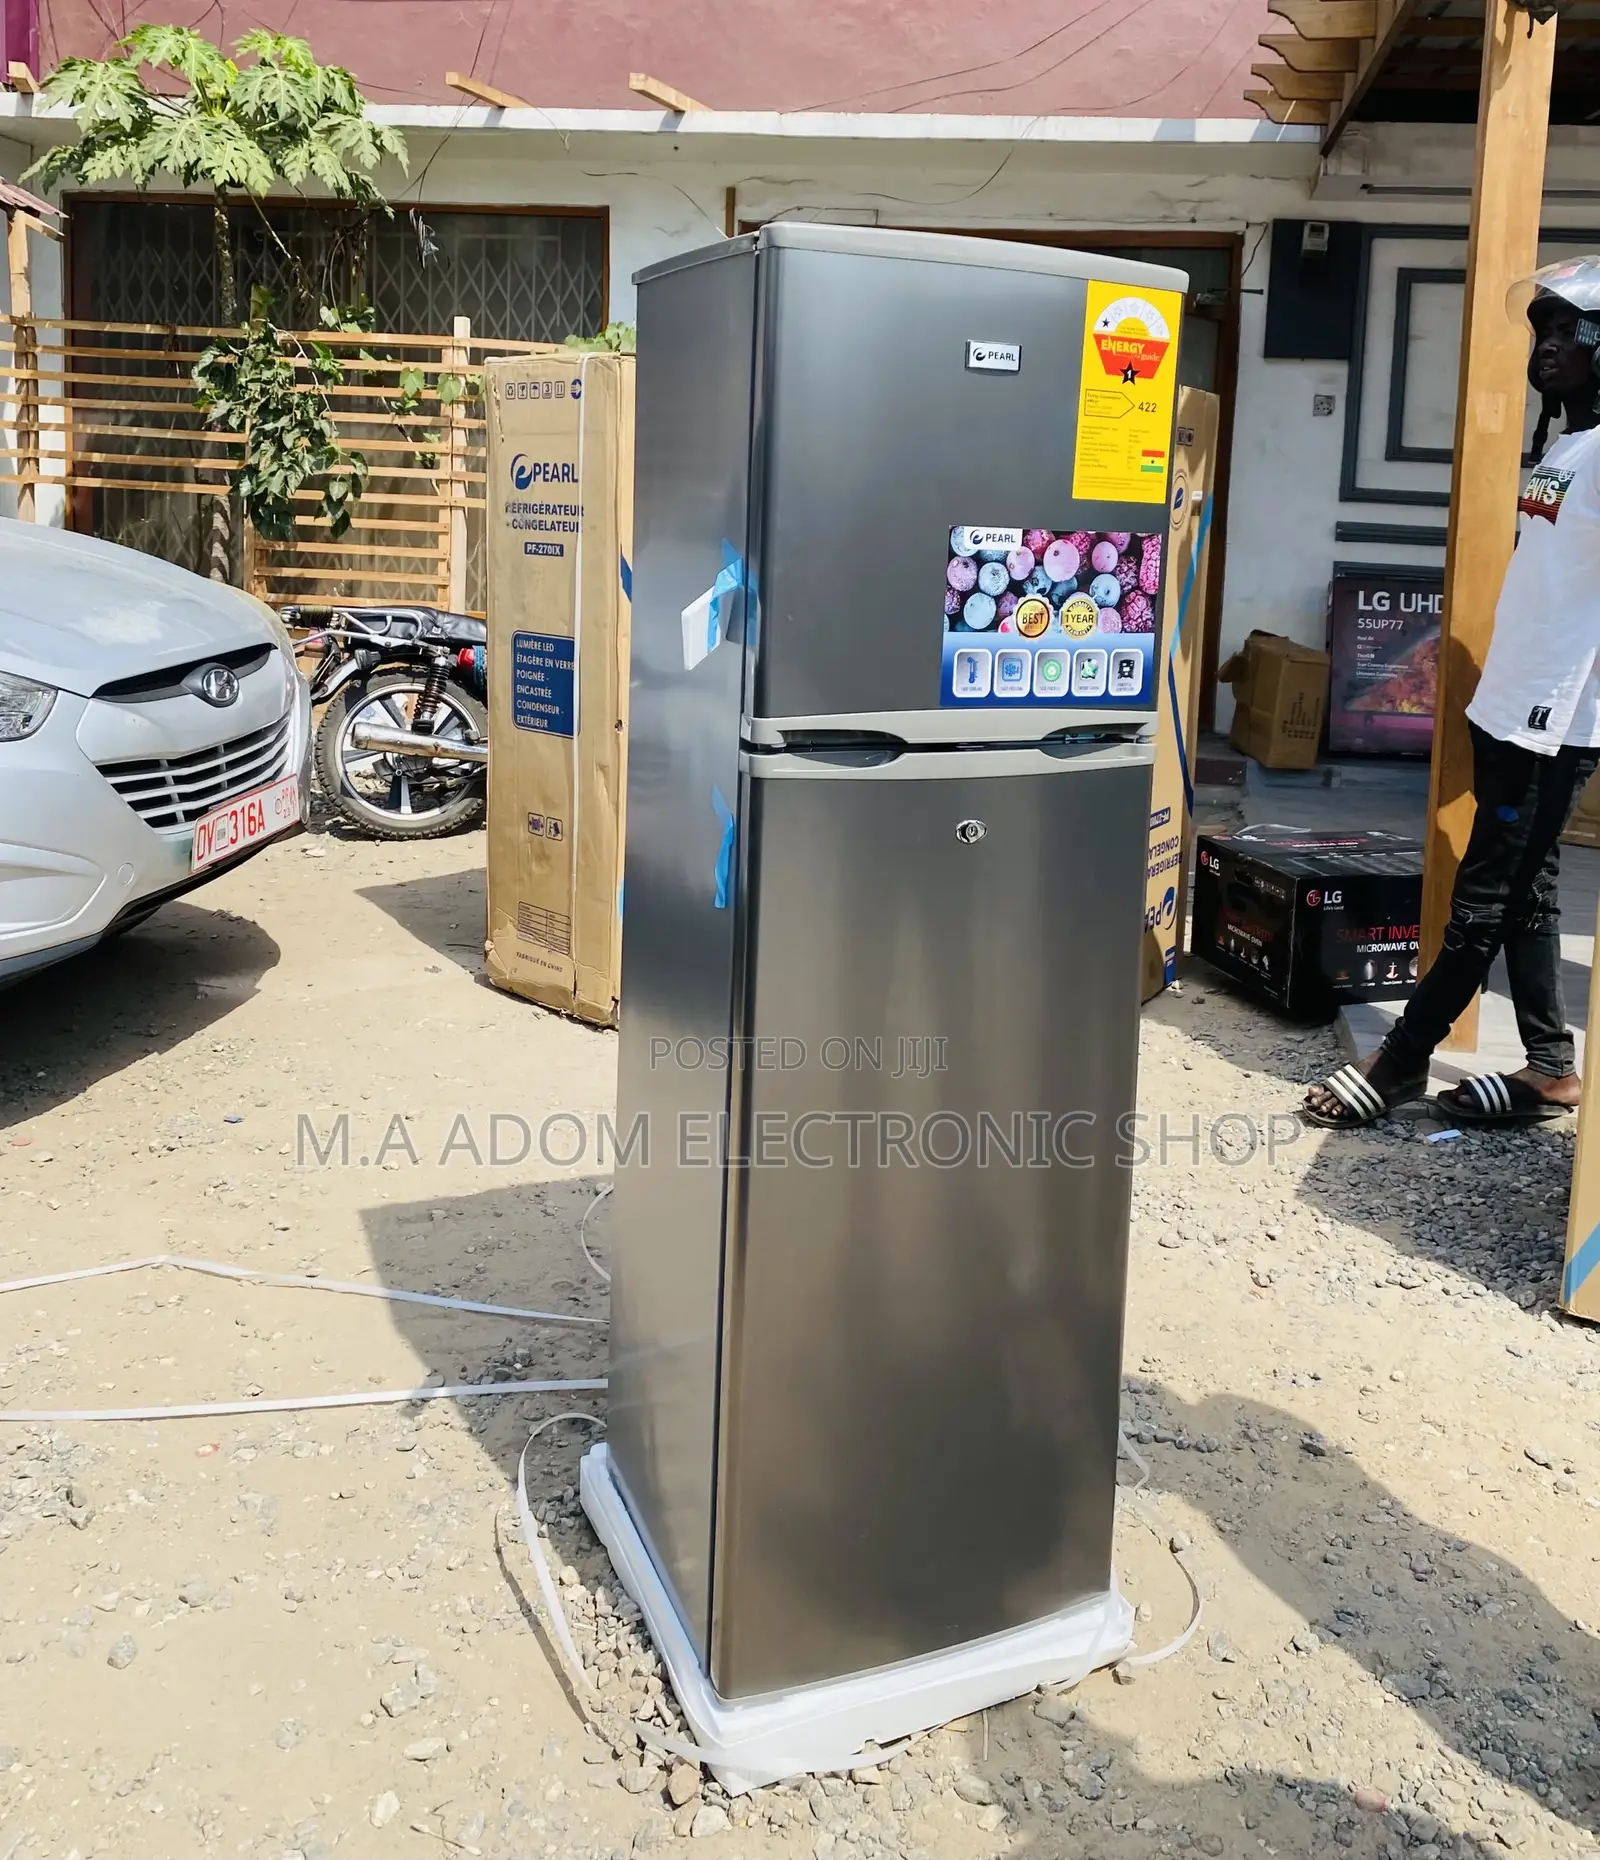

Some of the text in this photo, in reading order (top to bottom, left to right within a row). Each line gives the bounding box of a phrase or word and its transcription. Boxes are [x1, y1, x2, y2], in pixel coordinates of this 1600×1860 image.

[1100, 336, 1145, 355] ENERGY
[988, 351, 1016, 361] PEARL
[1127, 369, 1132, 379] 1
[1138, 401, 1157, 413] 422
[533, 462, 579, 483] PEARL
[985, 533, 1016, 543] PEARL
[526, 543, 561, 555] PF-270IX
[1358, 590, 1391, 611] LG
[1022, 611, 1045, 625] BEST
[1071, 614, 1094, 624] YEAR
[1357, 617, 1404, 631] 55UP77
[516, 638, 555, 652] LUMIÈRE LED
[516, 652, 544, 667] ÉTAGÈRE
[545, 657, 553, 668] EN
[516, 669, 545, 682] POIGNÉE
[516, 684, 552, 698] ENCASTRÉE
[516, 699, 560, 715] CONDENSEUR
[516, 713, 548, 728] EXTÉRIEUR
[196, 820, 215, 860] DV
[229, 798, 265, 845] 316A
[1209, 856, 1220, 870] LG
[1323, 890, 1342, 904] LG
[1356, 942, 1407, 953] MICROWAVE
